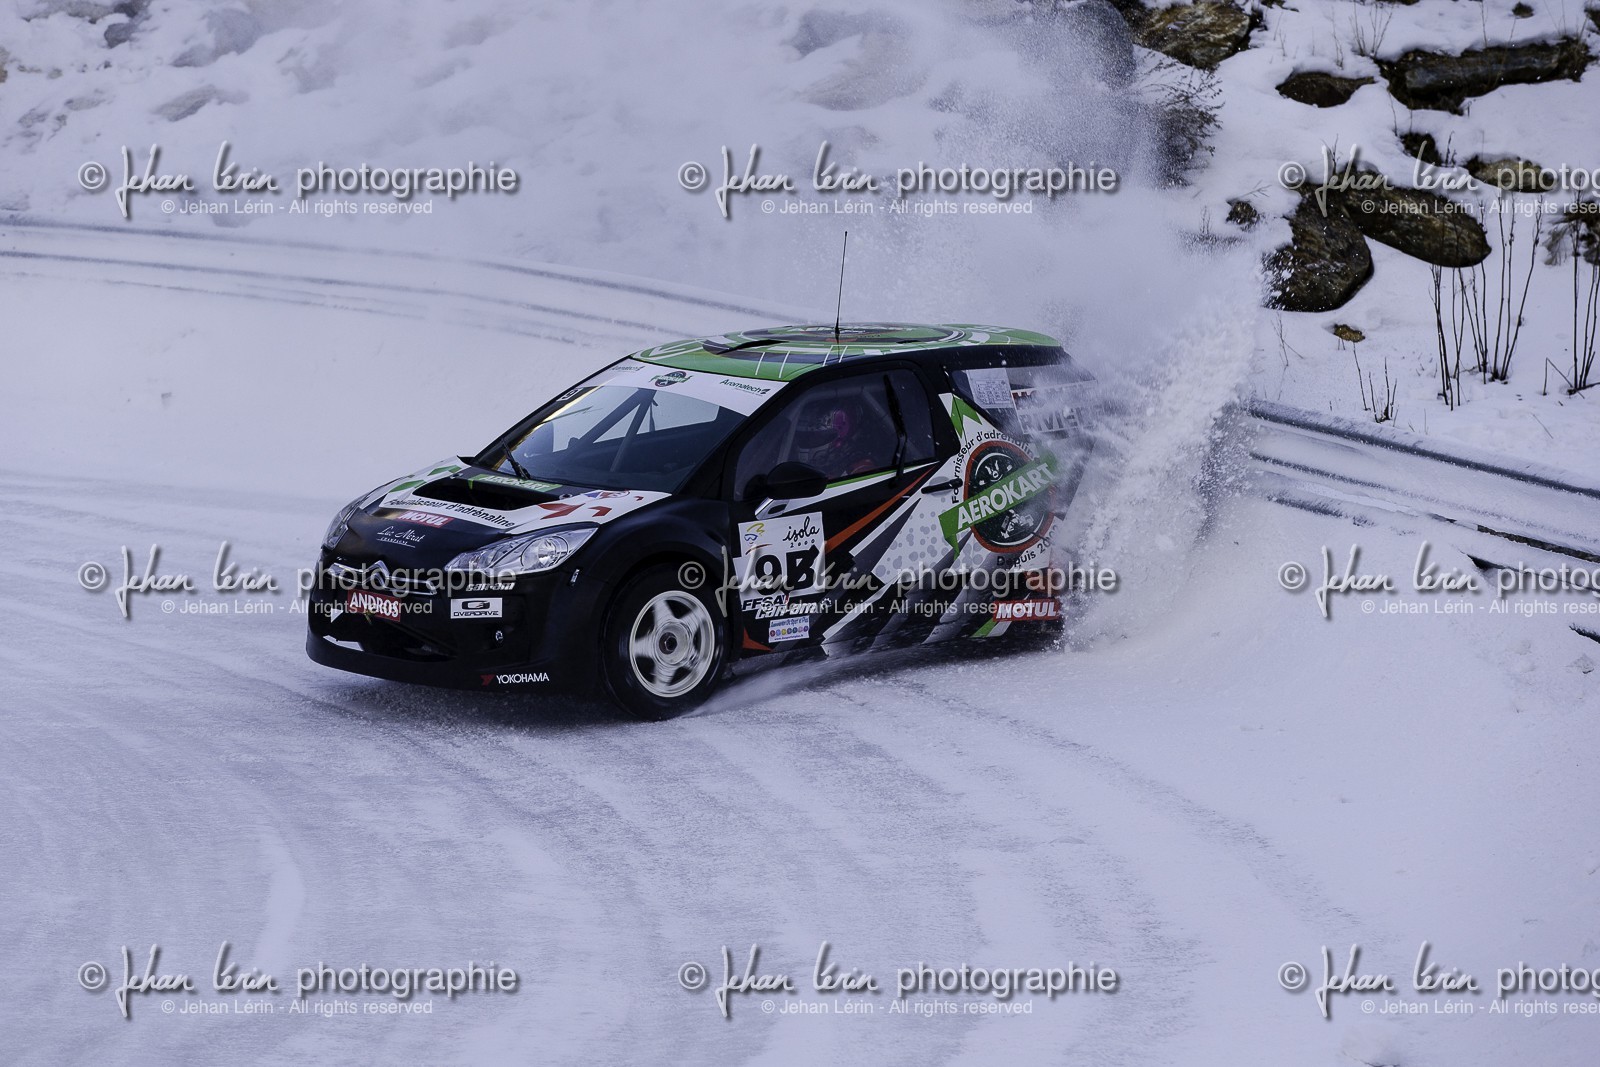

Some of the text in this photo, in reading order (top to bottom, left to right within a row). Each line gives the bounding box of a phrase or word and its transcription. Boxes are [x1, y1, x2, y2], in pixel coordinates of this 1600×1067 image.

[719, 379, 762, 393] Aromatech
[952, 439, 976, 504] Fornisseur
[957, 462, 1057, 529] AEROKART
[398, 511, 449, 526] MOTUL
[446, 502, 515, 528] d'adrénaline
[782, 515, 820, 542] isola
[789, 539, 815, 548] 2000
[997, 550, 1036, 567] Depuis
[350, 592, 399, 618] ANDROS
[742, 595, 785, 611] FFSA
[995, 601, 1057, 620] MOTUL
[496, 672, 550, 684] YOKOHAMA
